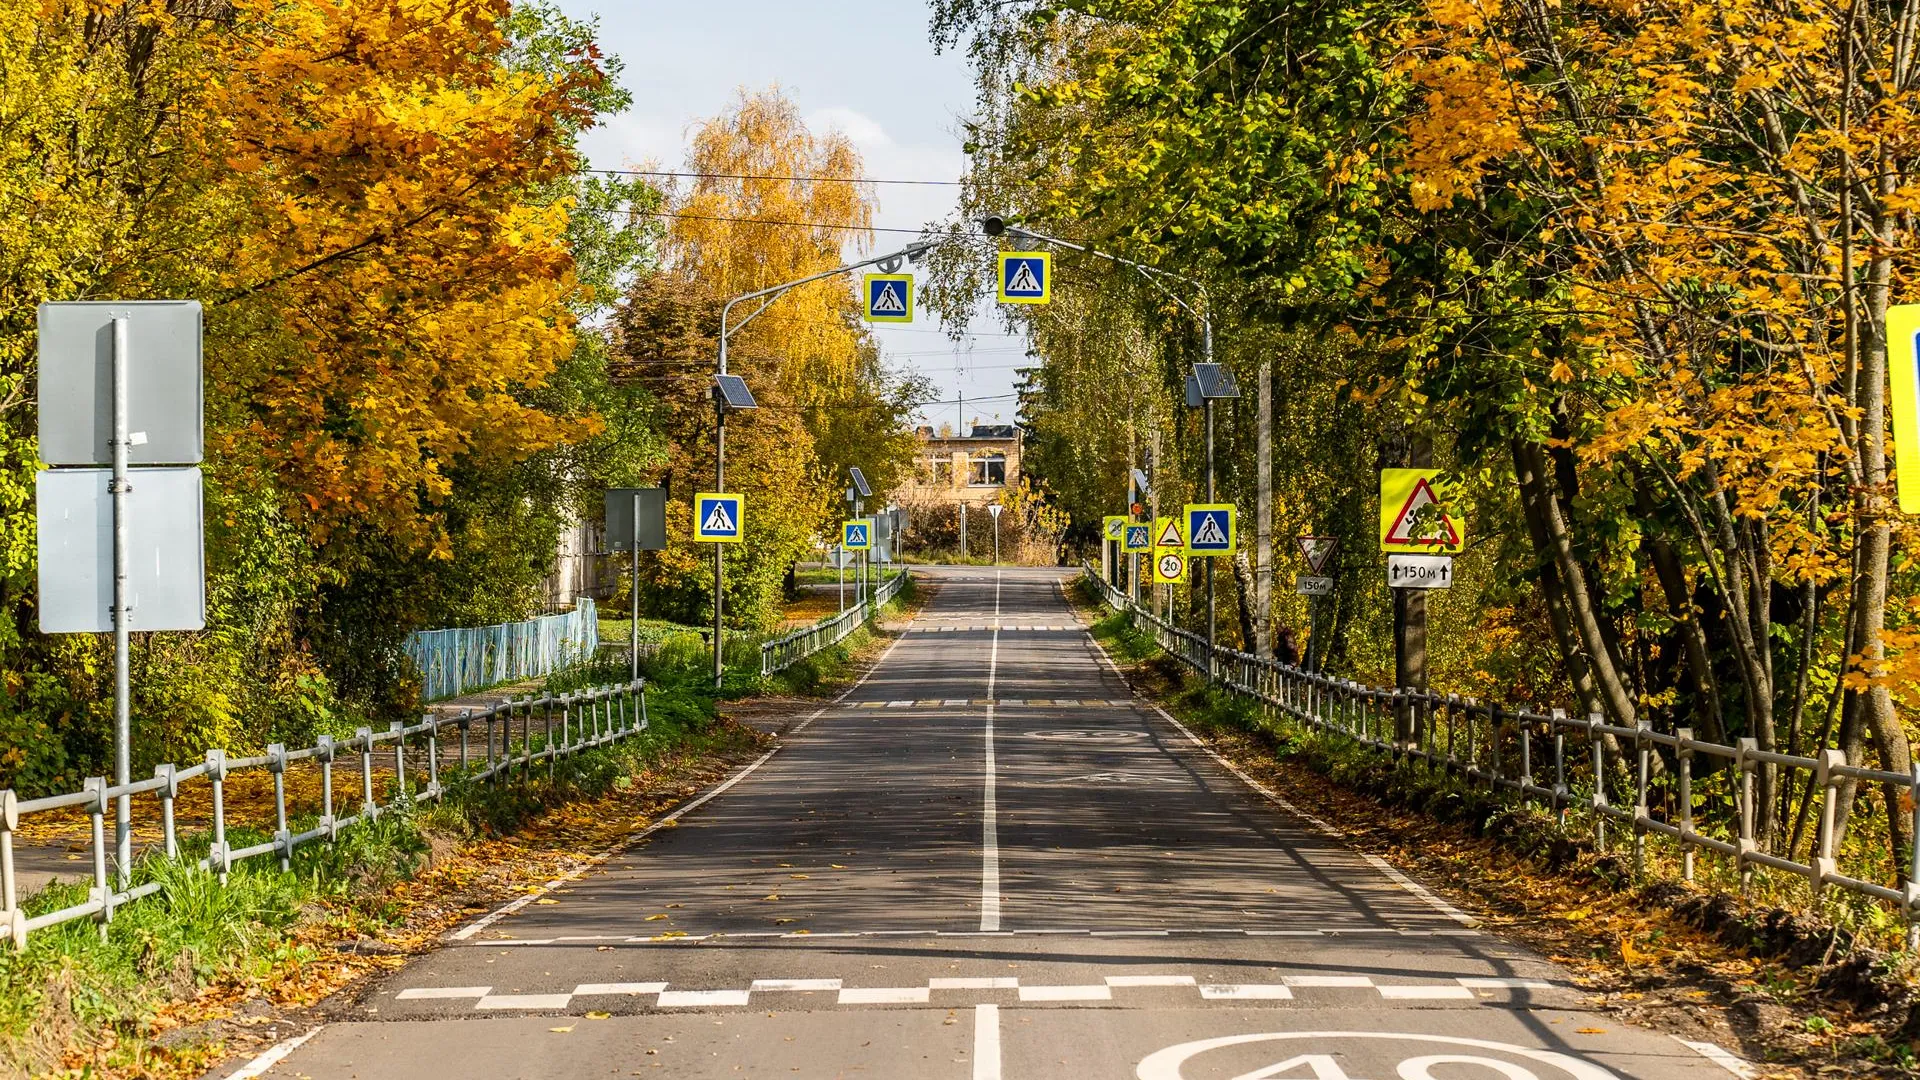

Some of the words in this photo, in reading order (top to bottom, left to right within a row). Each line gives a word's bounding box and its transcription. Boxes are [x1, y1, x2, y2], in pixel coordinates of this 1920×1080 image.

[1164, 561, 1177, 571] 20
[1403, 566, 1436, 578] 150м
[1304, 581, 1326, 590] 150м
